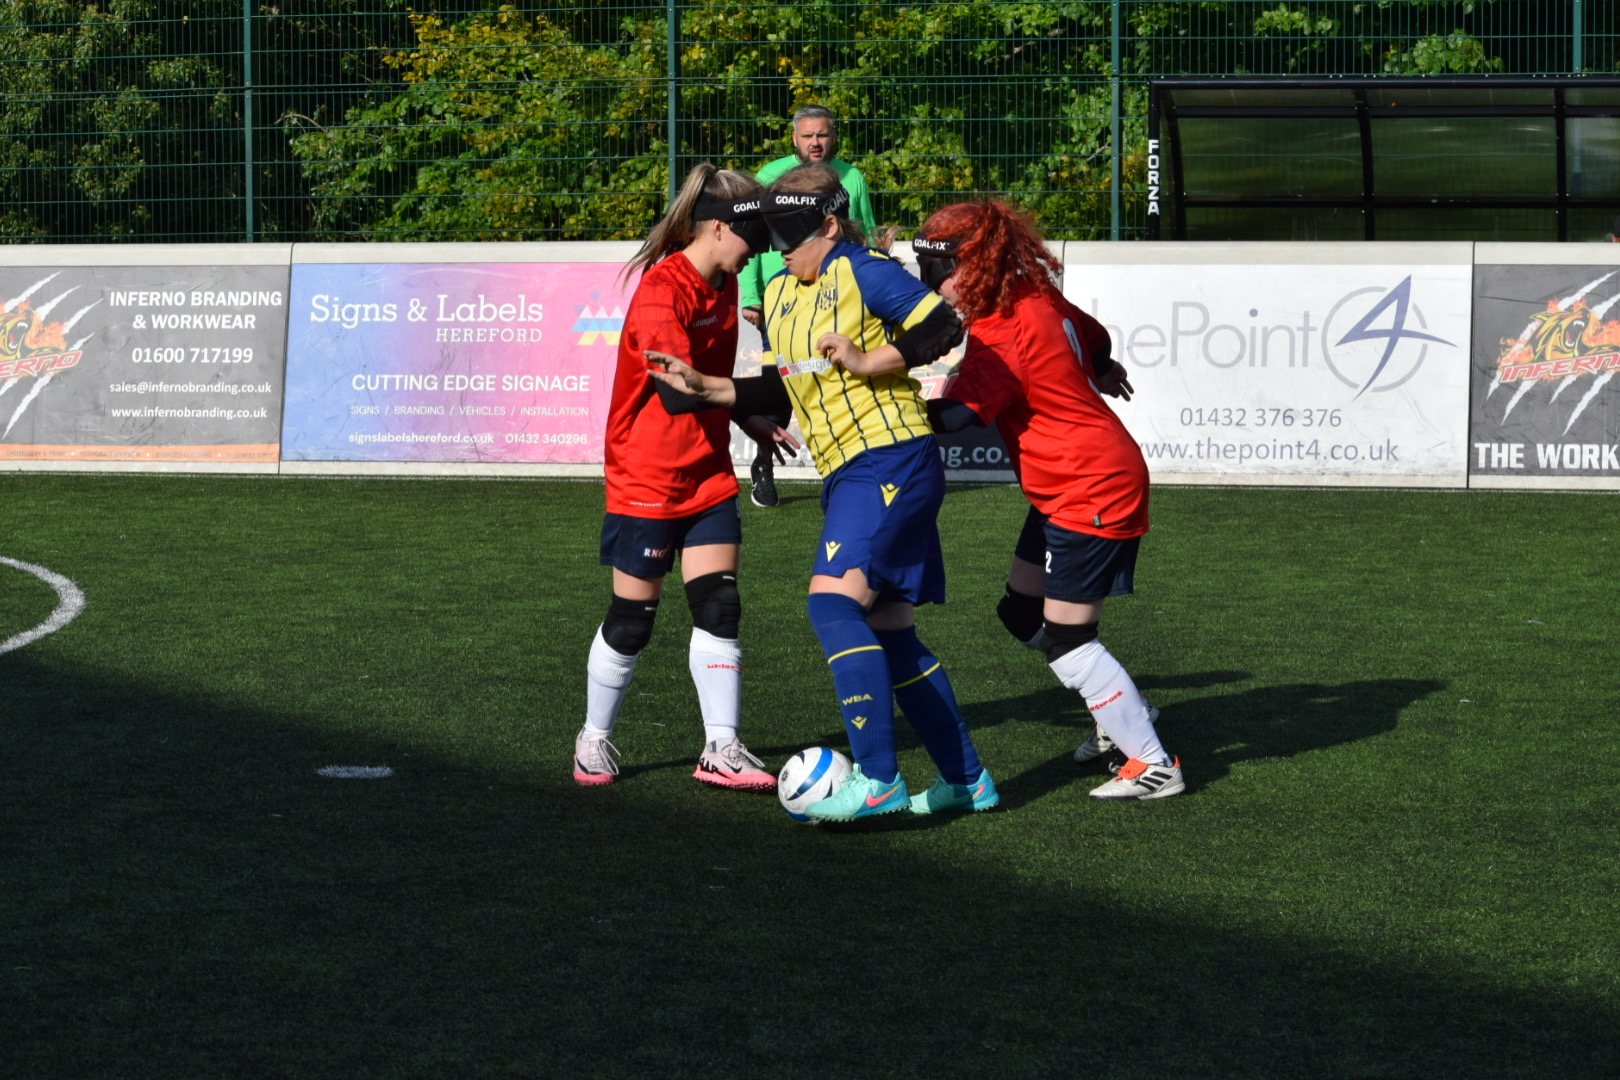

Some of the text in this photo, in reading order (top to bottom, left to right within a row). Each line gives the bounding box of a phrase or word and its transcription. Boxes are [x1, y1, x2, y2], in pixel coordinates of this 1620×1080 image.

[1147, 139, 1160, 216] FORZA
[775, 195, 817, 206] GOALFIX
[914, 238, 946, 251] GOALFIX
[109, 291, 283, 307] INFERNO BRANDING
[309, 294, 544, 329] Signs & Labels
[132, 314, 256, 330] & WORKWEAR
[435, 328, 543, 343] HEREFORD
[1091, 298, 1318, 369] hePoint
[131, 347, 254, 364] 01600 717199
[1501, 352, 1620, 383] INFERN
[109, 381, 272, 395] sales@infernobranding.co.uk
[352, 374, 590, 392] CUTTING EDGE SIGNAGE
[111, 406, 268, 420] www.infernobranding.co.uk
[350, 405, 380, 416] SIGNS
[394, 405, 445, 416] BRANDING
[459, 405, 506, 416] VEHICLES
[520, 405, 589, 417] INSTALLATION
[1180, 406, 1342, 428] 01432 376 376
[348, 431, 588, 446] signslabelshereford.co.uk 01432 340296
[1140, 436, 1399, 464] ww.thepoint4.co.uk
[1474, 442, 1620, 470] THE WORK
[842, 693, 873, 706] WBA
